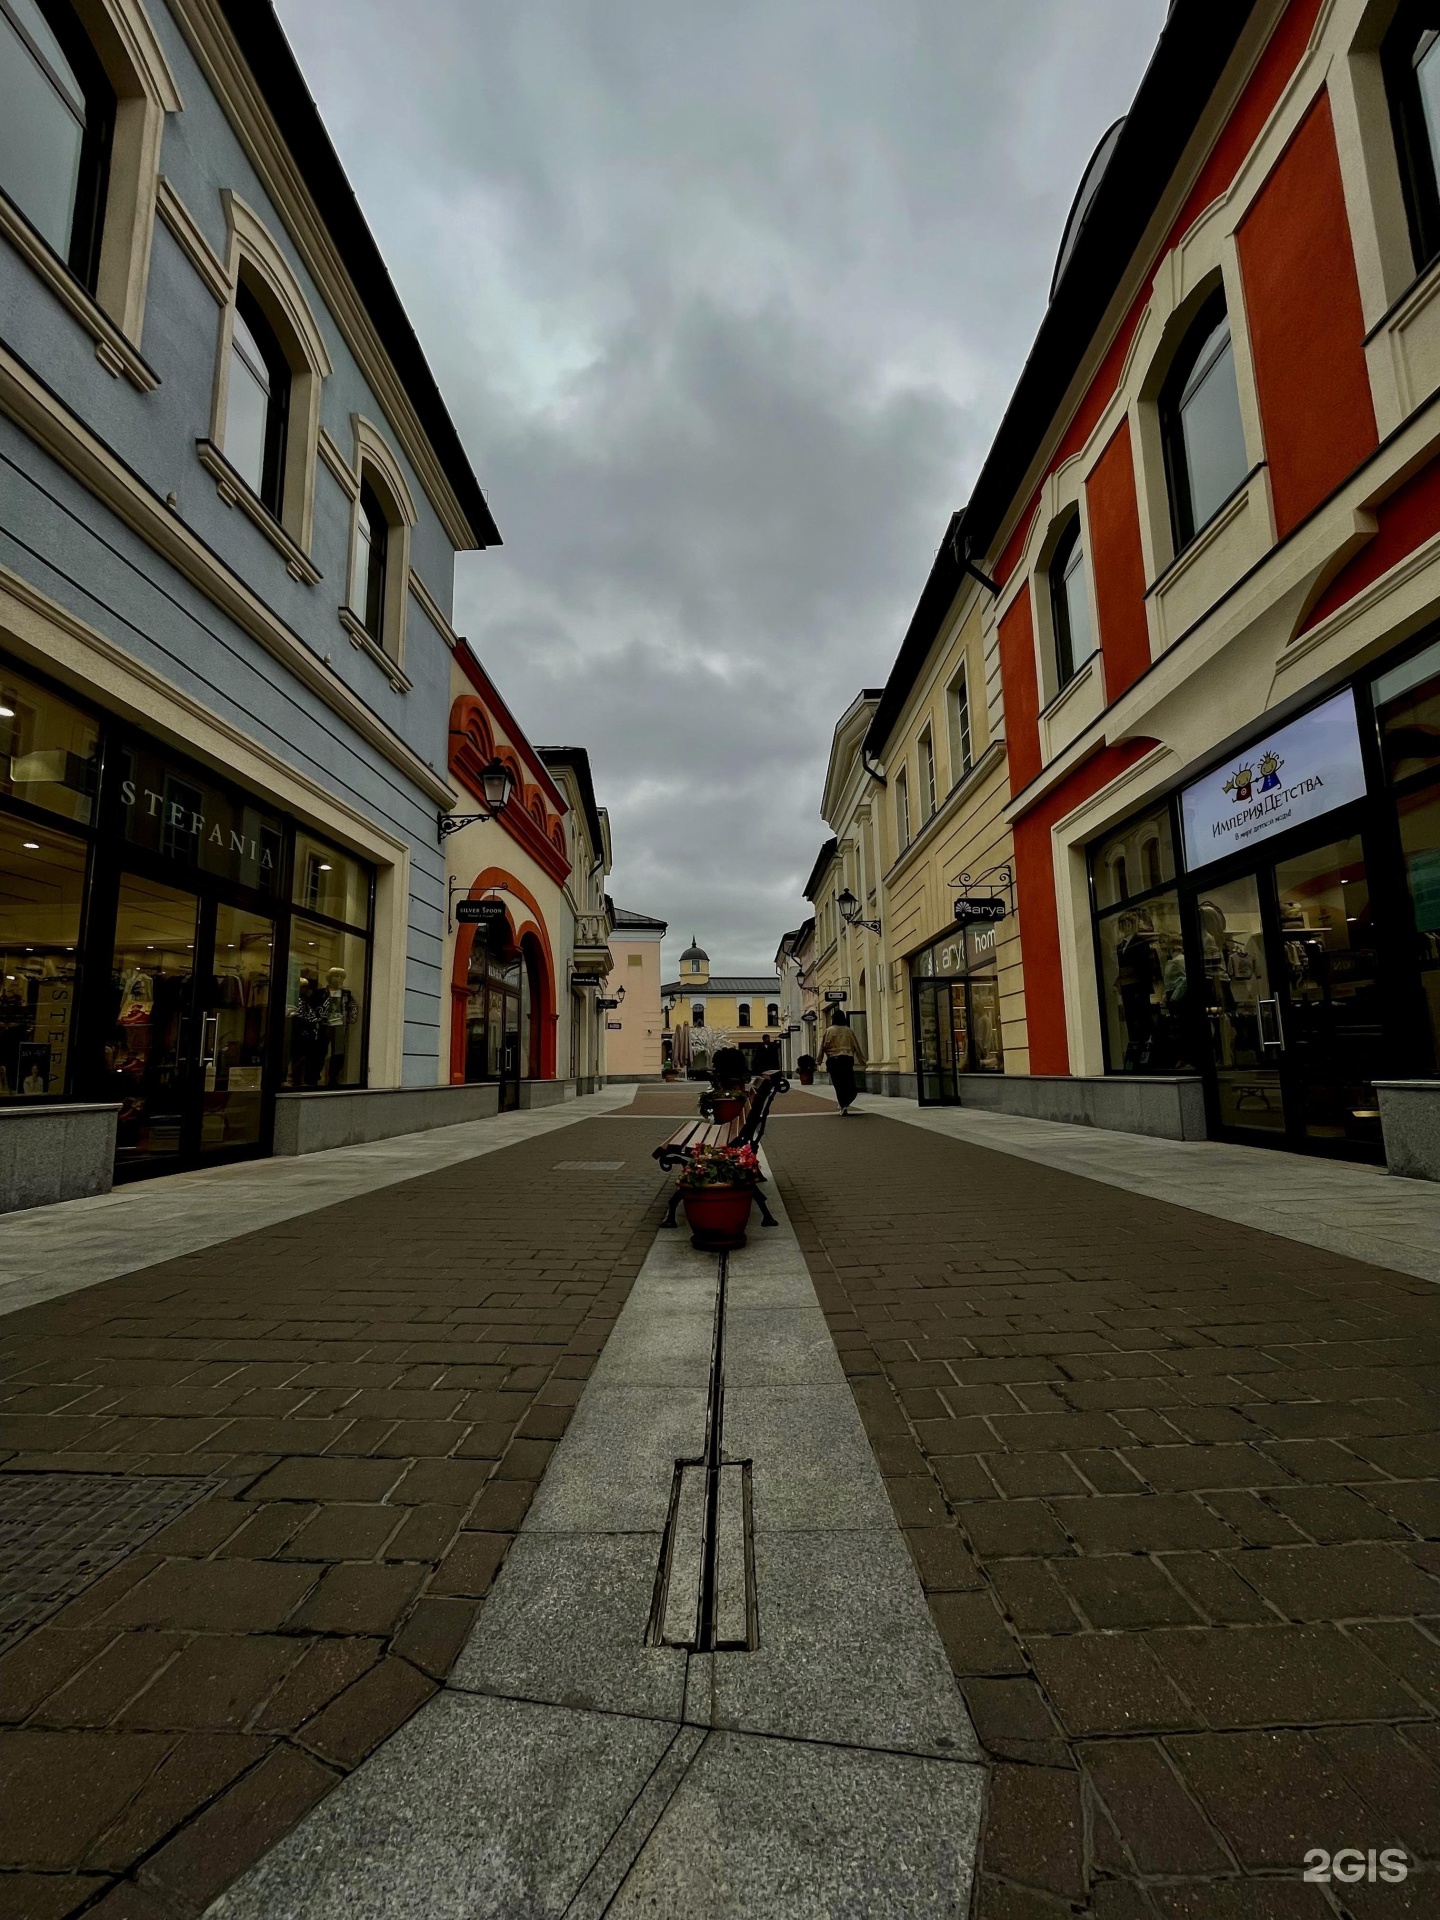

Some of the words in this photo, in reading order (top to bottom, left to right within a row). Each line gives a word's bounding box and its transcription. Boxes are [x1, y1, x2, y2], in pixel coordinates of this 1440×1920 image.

[121, 780, 273, 868] STEFANIA
[482, 906, 502, 914] SPOON
[972, 906, 1005, 917] arya
